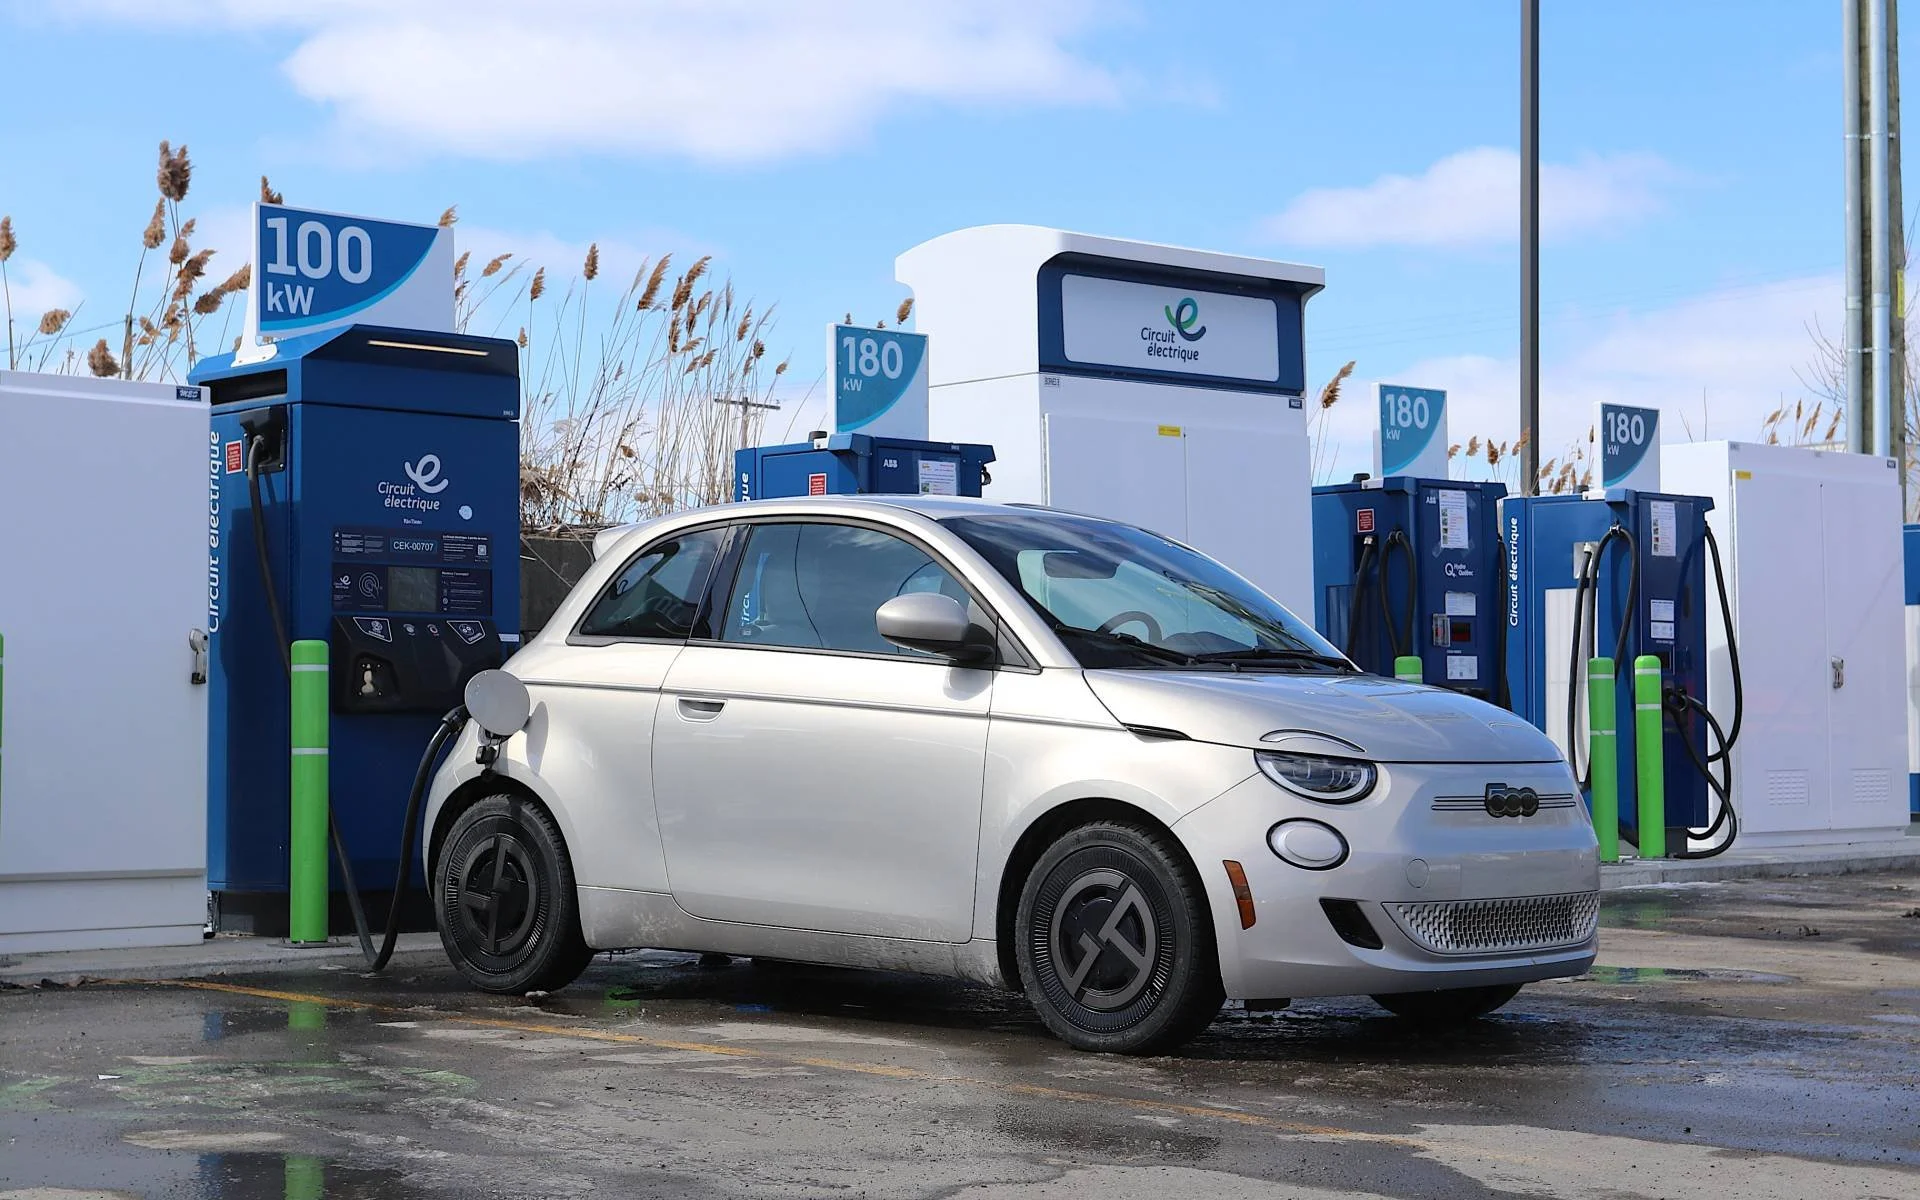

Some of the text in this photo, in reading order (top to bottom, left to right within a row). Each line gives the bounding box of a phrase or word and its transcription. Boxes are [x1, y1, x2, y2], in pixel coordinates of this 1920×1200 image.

[266, 217, 372, 284] 100
[267, 282, 314, 316] kW
[1140, 327, 1176, 344] Circuit
[843, 336, 903, 380] 180
[1147, 342, 1199, 363] électrique
[843, 378, 863, 392] kW
[1385, 394, 1430, 429] 180
[1386, 428, 1401, 441] kW
[1606, 412, 1645, 446] 180
[1607, 444, 1620, 456] kW
[883, 459, 898, 468] ABB
[377, 481, 415, 496] Circuit
[384, 495, 440, 512] électrique
[393, 541, 434, 551] CEK-00707
[1510, 517, 1519, 626] Circuit électrique
[1485, 783, 1539, 818] 500
